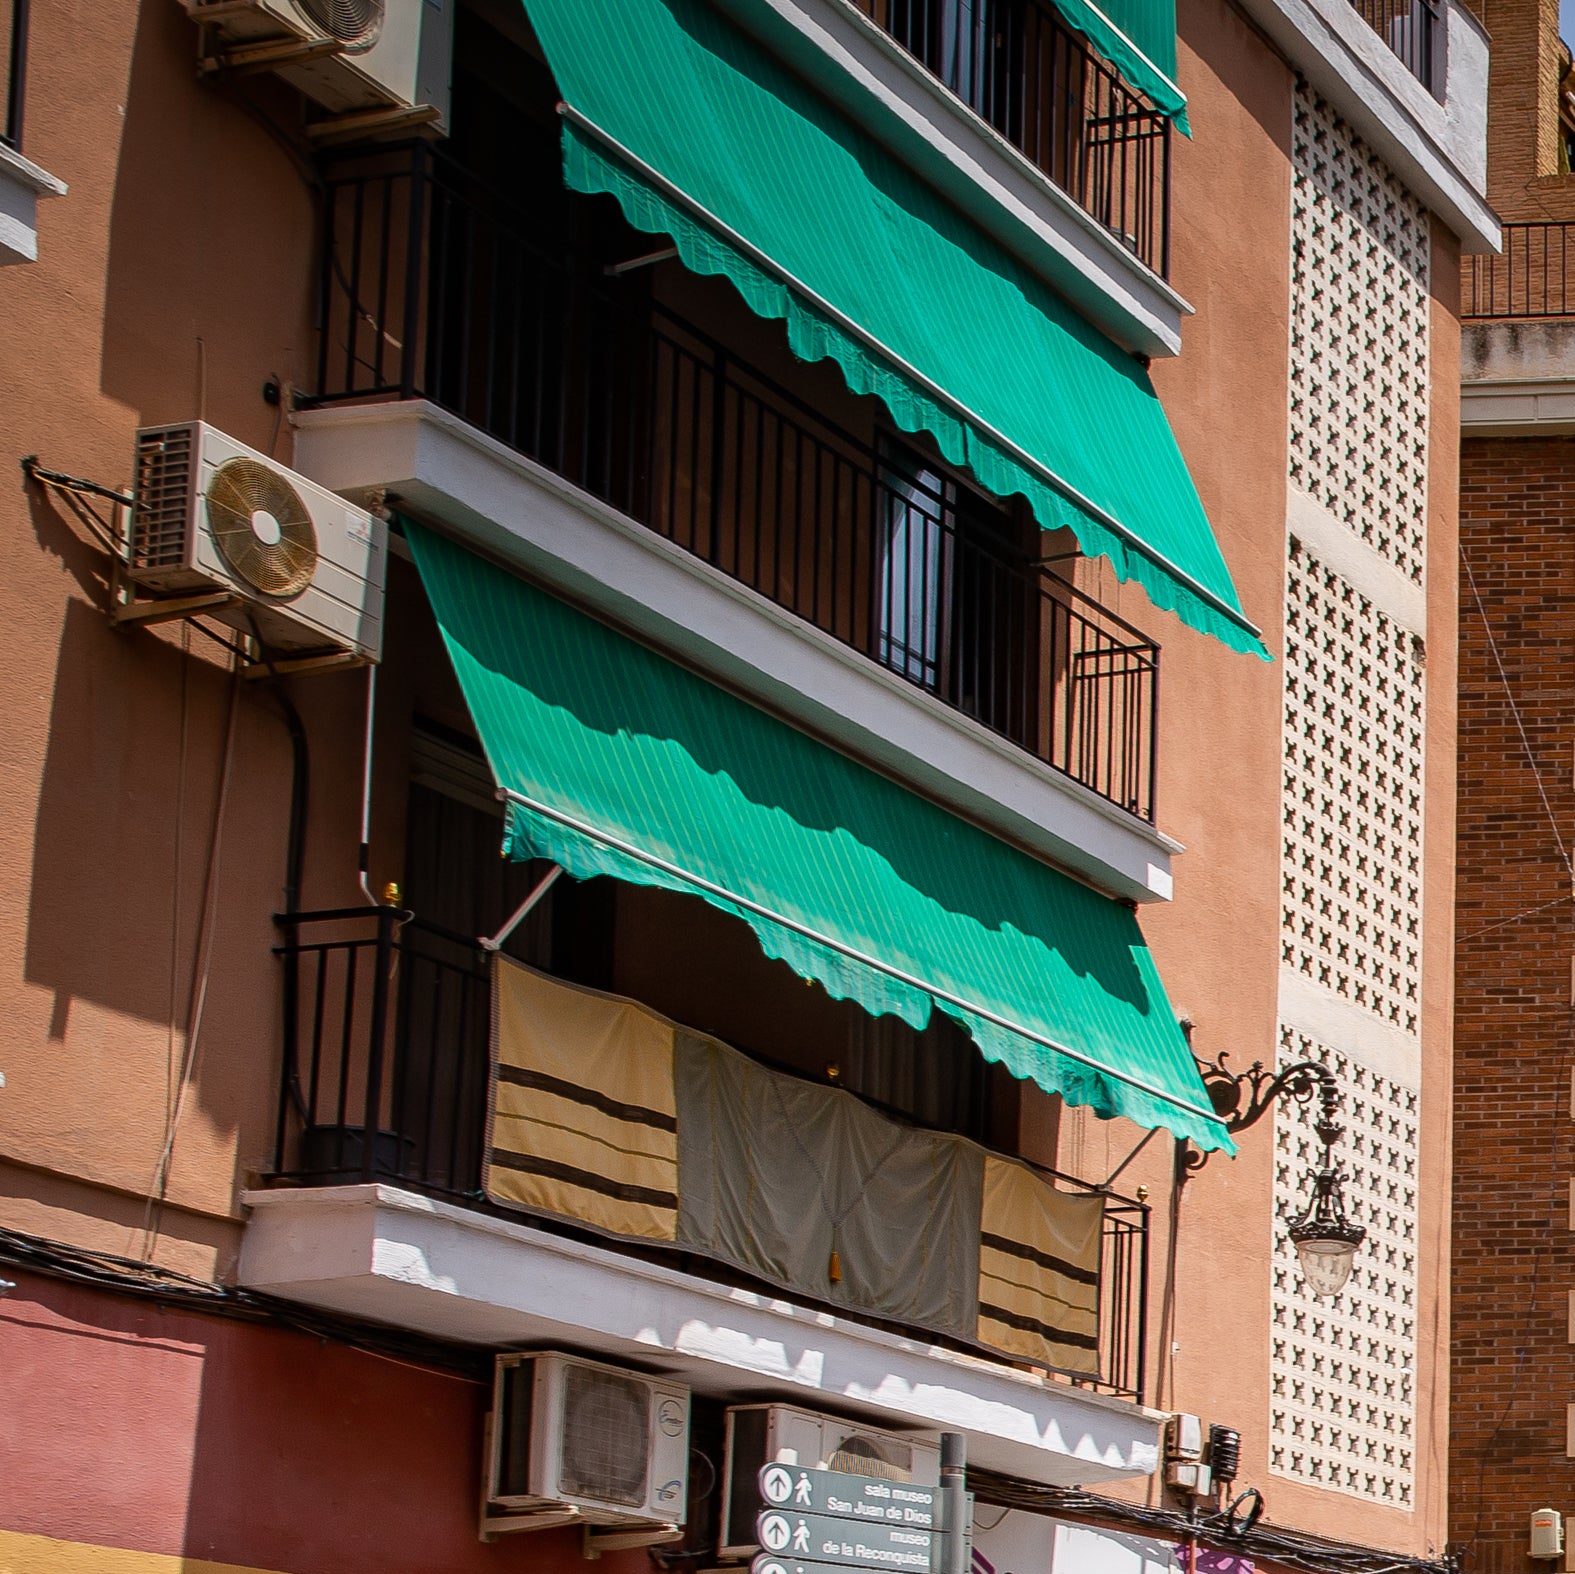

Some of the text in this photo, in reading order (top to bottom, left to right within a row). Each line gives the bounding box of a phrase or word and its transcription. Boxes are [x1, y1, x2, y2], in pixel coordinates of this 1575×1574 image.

[864, 1484, 933, 1505] sala museo
[827, 1496, 932, 1524] San Juan de Dios
[890, 1531, 931, 1546] museo
[822, 1541, 930, 1566] de la Reconquista
